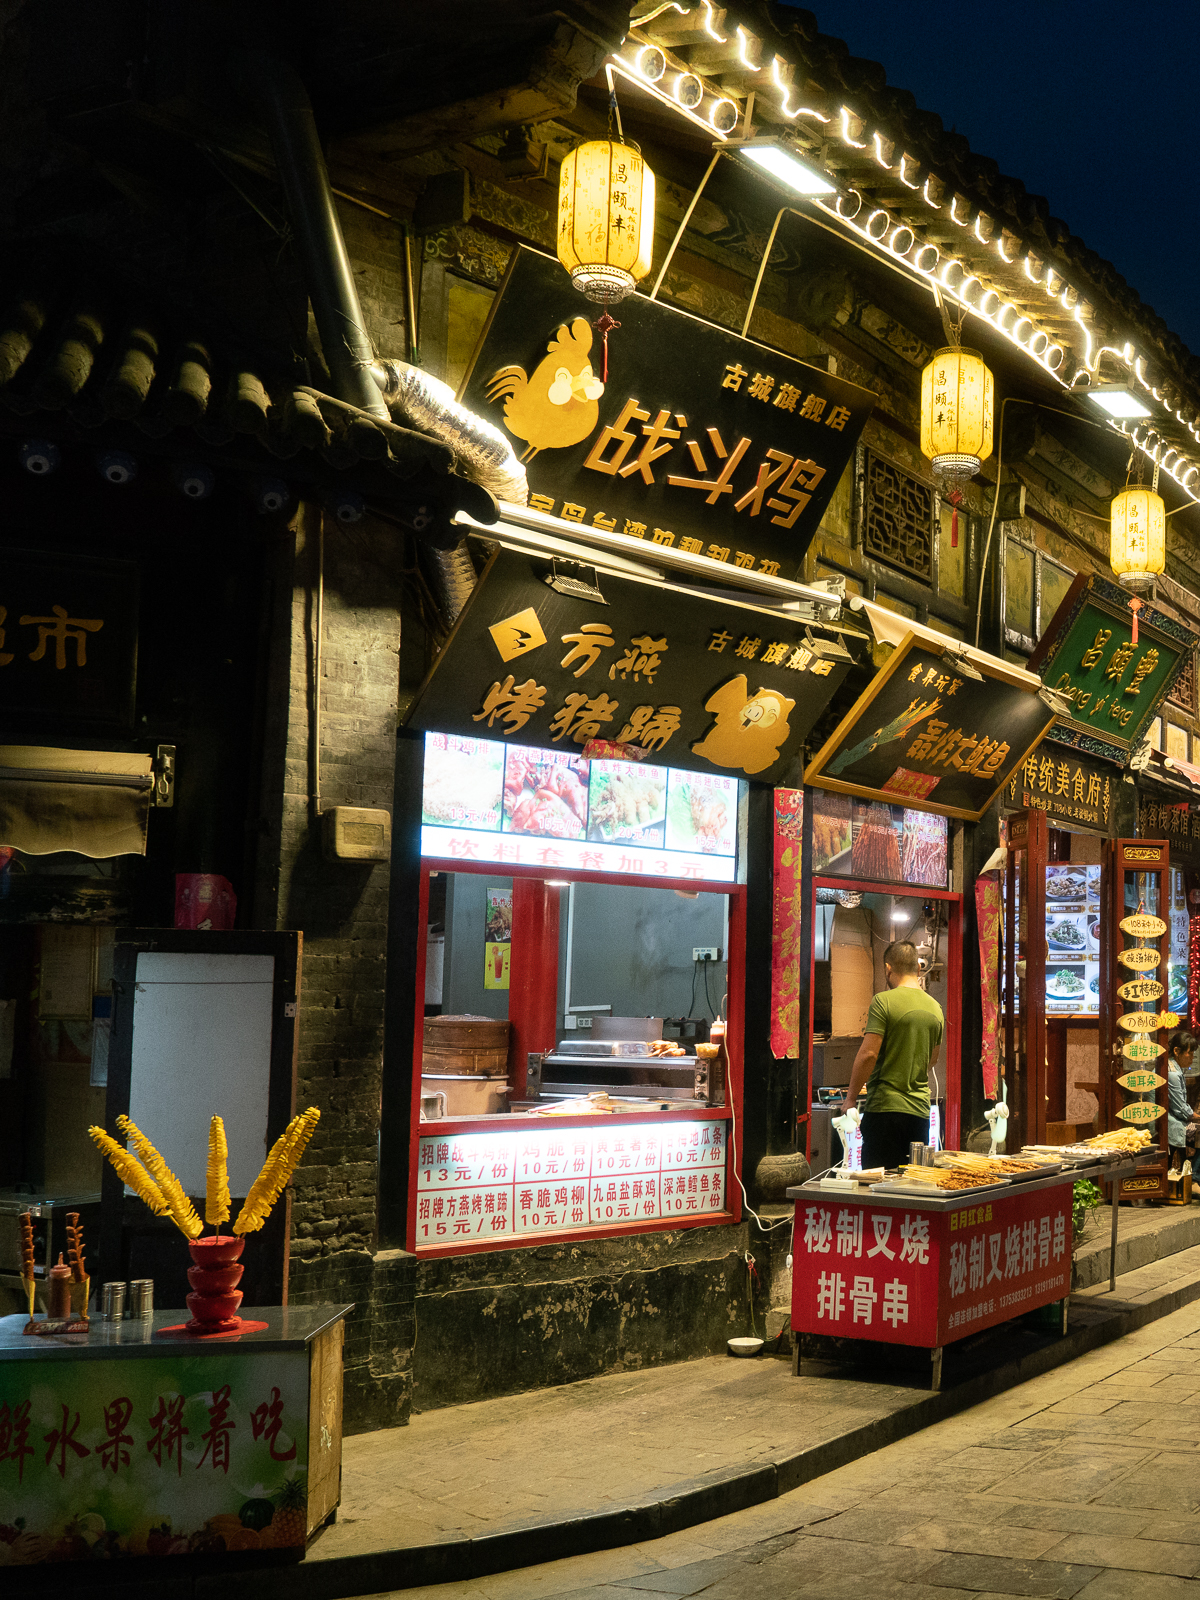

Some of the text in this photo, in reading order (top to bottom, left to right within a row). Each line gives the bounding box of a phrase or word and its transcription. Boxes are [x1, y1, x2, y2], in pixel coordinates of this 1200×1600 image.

[721, 363, 852, 433] 古城旗舰店
[583, 398, 827, 530] 战斗鸡
[0, 604, 104, 670] 市
[561, 622, 669, 685] 方燕
[708, 630, 836, 678] 古城旗舰店
[472, 674, 682, 754] 烤猪蹄
[432, 735, 490, 755] 战斗鸡排
[516, 748, 582, 769] 方燕烤猪蹄
[599, 759, 661, 780] 轰炸大鱿鱼
[674, 771, 732, 791] 台湾鸡翅包饭
[1021, 753, 1102, 807] 传统美食府
[450, 808, 498, 825] 13元/份
[539, 817, 582, 834] 15元/份
[619, 826, 659, 843] 20元/份
[694, 836, 731, 850] 15元/份
[448, 837, 705, 880] 饮料套餐加3元
[1126, 1074, 1156, 1088] 猫耳朵
[1122, 1105, 1161, 1120] 山药丸子
[598, 1152, 657, 1170] 10元/份
[666, 1147, 722, 1164] 10元/份
[423, 1163, 508, 1183] 13元/份
[522, 1158, 586, 1176] 10元/份
[593, 1178, 657, 1204] 九品盐酥鸡
[663, 1172, 722, 1197] 深海鳕鱼条
[419, 1191, 508, 1220] 招牌方燕烤猪蹄
[519, 1184, 585, 1211] 香脆鸡柳
[665, 1193, 721, 1211] 10元/份
[521, 1207, 584, 1227] 10元/份
[594, 1200, 656, 1219] 10元/份
[950, 1204, 993, 1232] 日月红食品
[421, 1214, 508, 1237] 15元/份
[803, 1206, 930, 1265] 秘制叉烧
[948, 1210, 1066, 1299] 秘制叉烧排骨串
[816, 1270, 909, 1328] 排骨串
